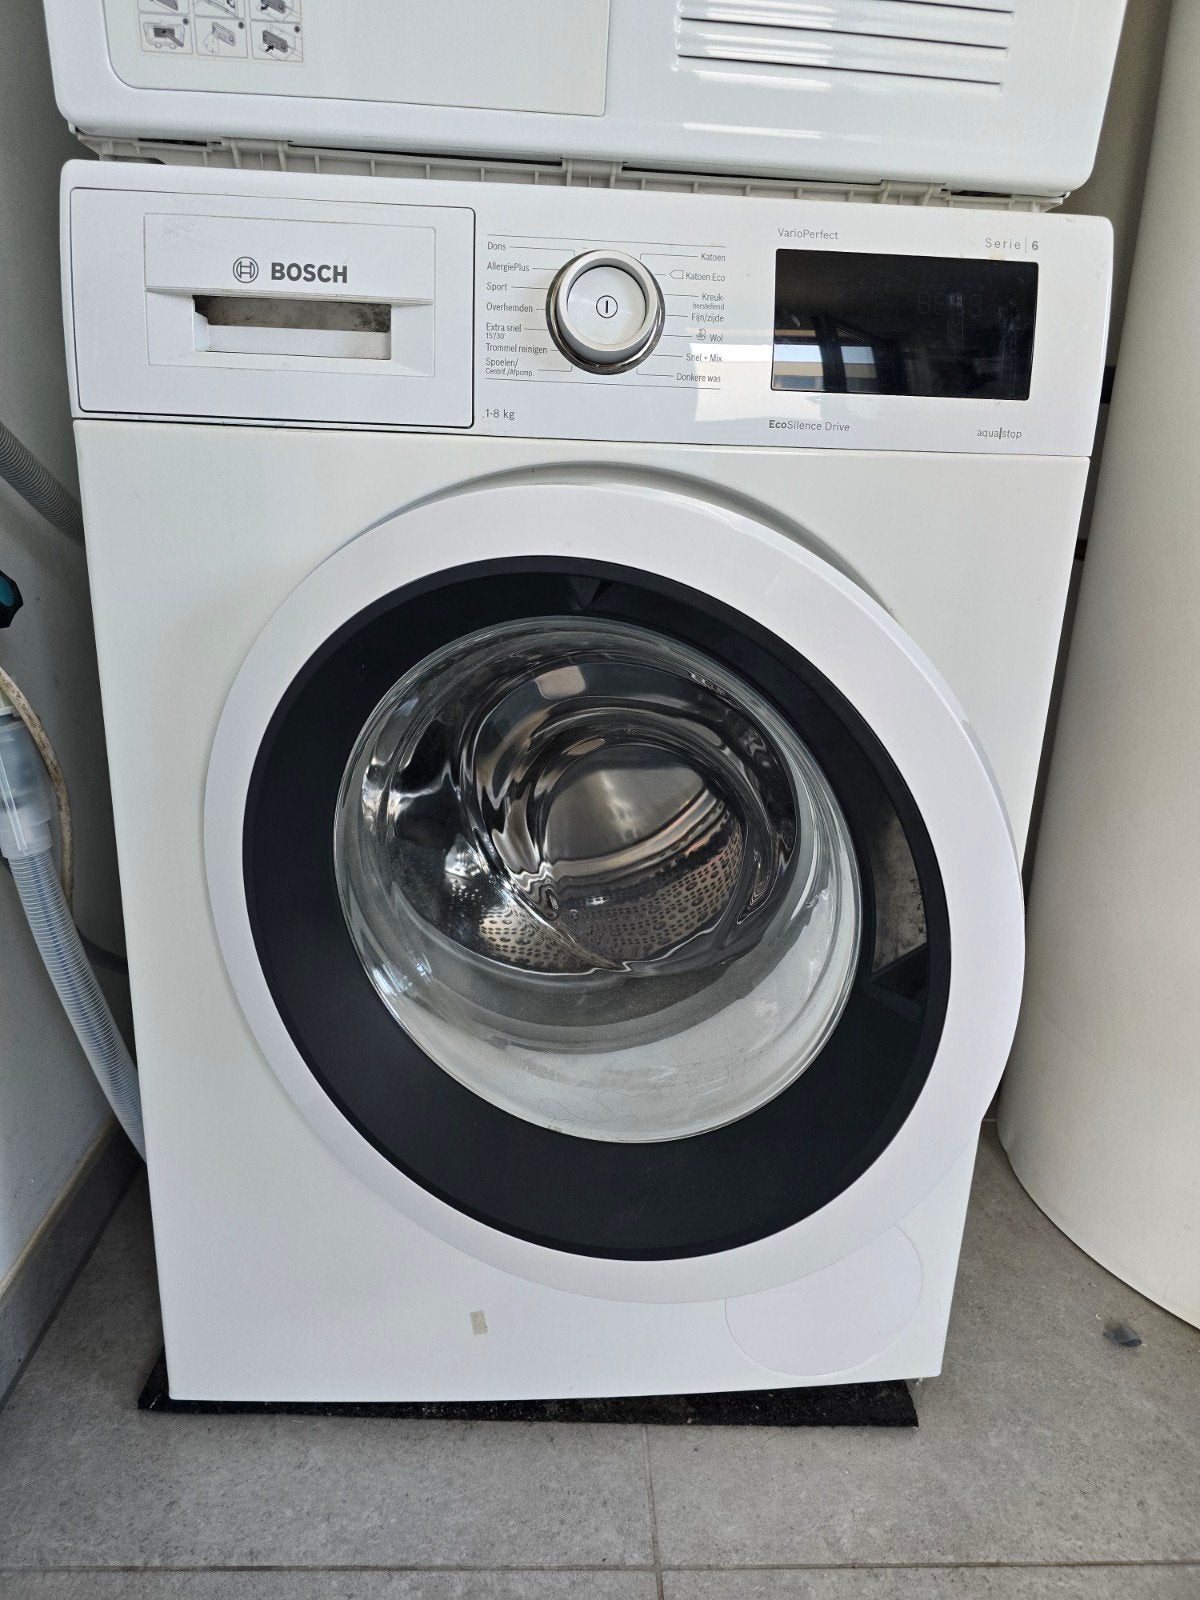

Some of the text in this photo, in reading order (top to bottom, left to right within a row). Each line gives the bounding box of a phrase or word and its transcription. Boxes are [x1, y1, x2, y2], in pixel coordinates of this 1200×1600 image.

[778, 228, 839, 240] VarioPerfect
[487, 241, 507, 251] Dons
[985, 237, 1039, 251] Serie 6
[701, 252, 726, 262] Katoen
[271, 262, 348, 283] BOSCH
[487, 262, 530, 273] AllergiePlus
[685, 271, 726, 282] Katoen Eco
[486, 282, 508, 291] Sport
[702, 293, 725, 301] Kreuk-
[486, 302, 533, 313] Overhemden
[691, 313, 725, 323] Fijn/zijde
[486, 322, 522, 332] Extra snel
[709, 333, 724, 343] Wol
[486, 342, 548, 355] Trommel reinigen
[686, 352, 702, 362] Snel
[710, 353, 723, 363] Mix
[676, 372, 722, 383] Donkere was
[485, 408, 515, 420] 1-8 kg
[768, 419, 850, 431] EcoSilence Drive
